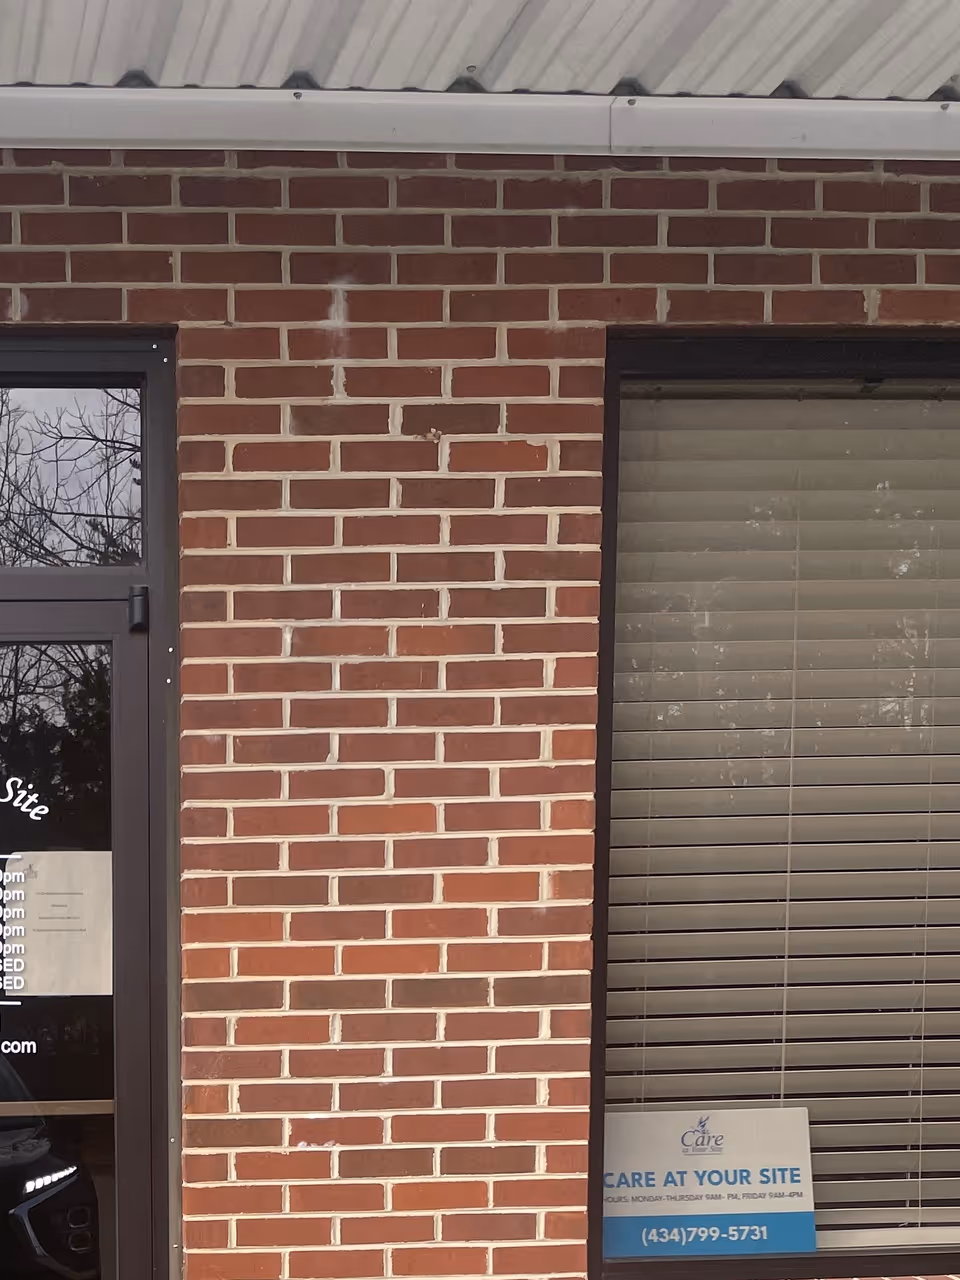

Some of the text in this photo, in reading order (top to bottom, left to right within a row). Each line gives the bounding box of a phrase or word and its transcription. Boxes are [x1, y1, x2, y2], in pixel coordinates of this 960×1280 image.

[681, 1131, 724, 1147] Care
[603, 1167, 801, 1188] CARE AT YOUR SITE
[742, 1192, 767, 1200] FRIDAY
[641, 1225, 768, 1247] (434)799-5731
